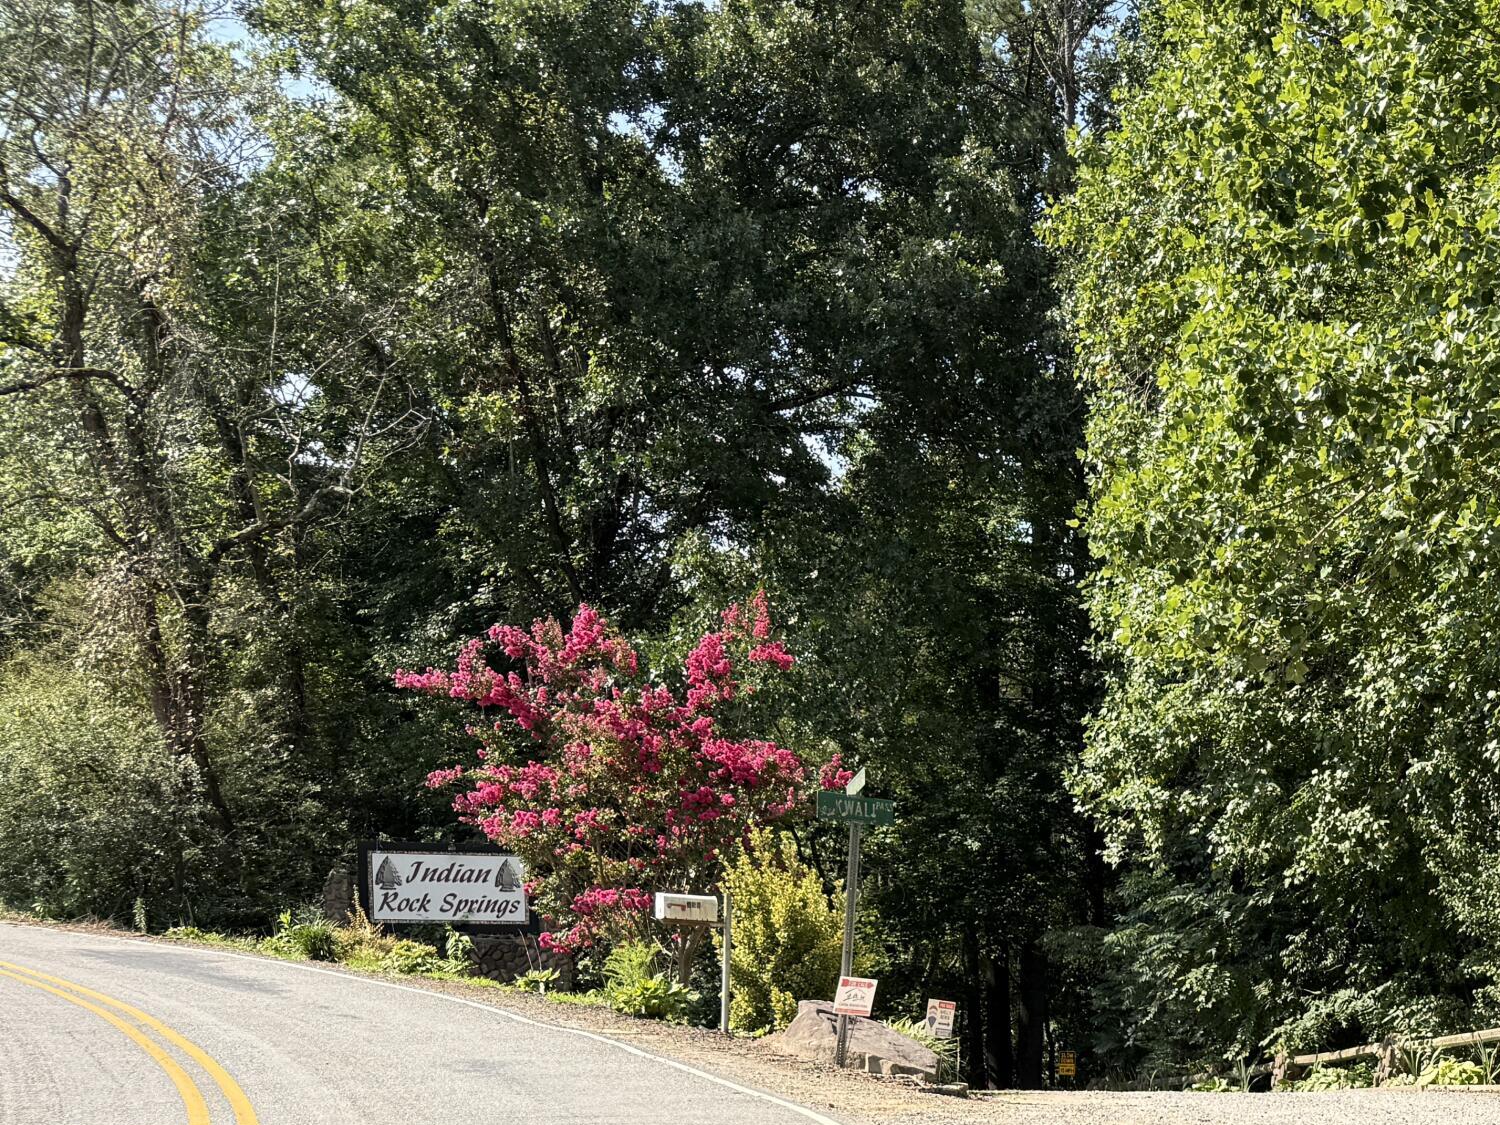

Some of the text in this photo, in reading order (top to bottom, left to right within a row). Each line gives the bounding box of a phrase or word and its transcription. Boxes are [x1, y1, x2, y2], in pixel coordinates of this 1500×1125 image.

[406, 861, 492, 884] Indian
[378, 891, 521, 919] Rock Springs
